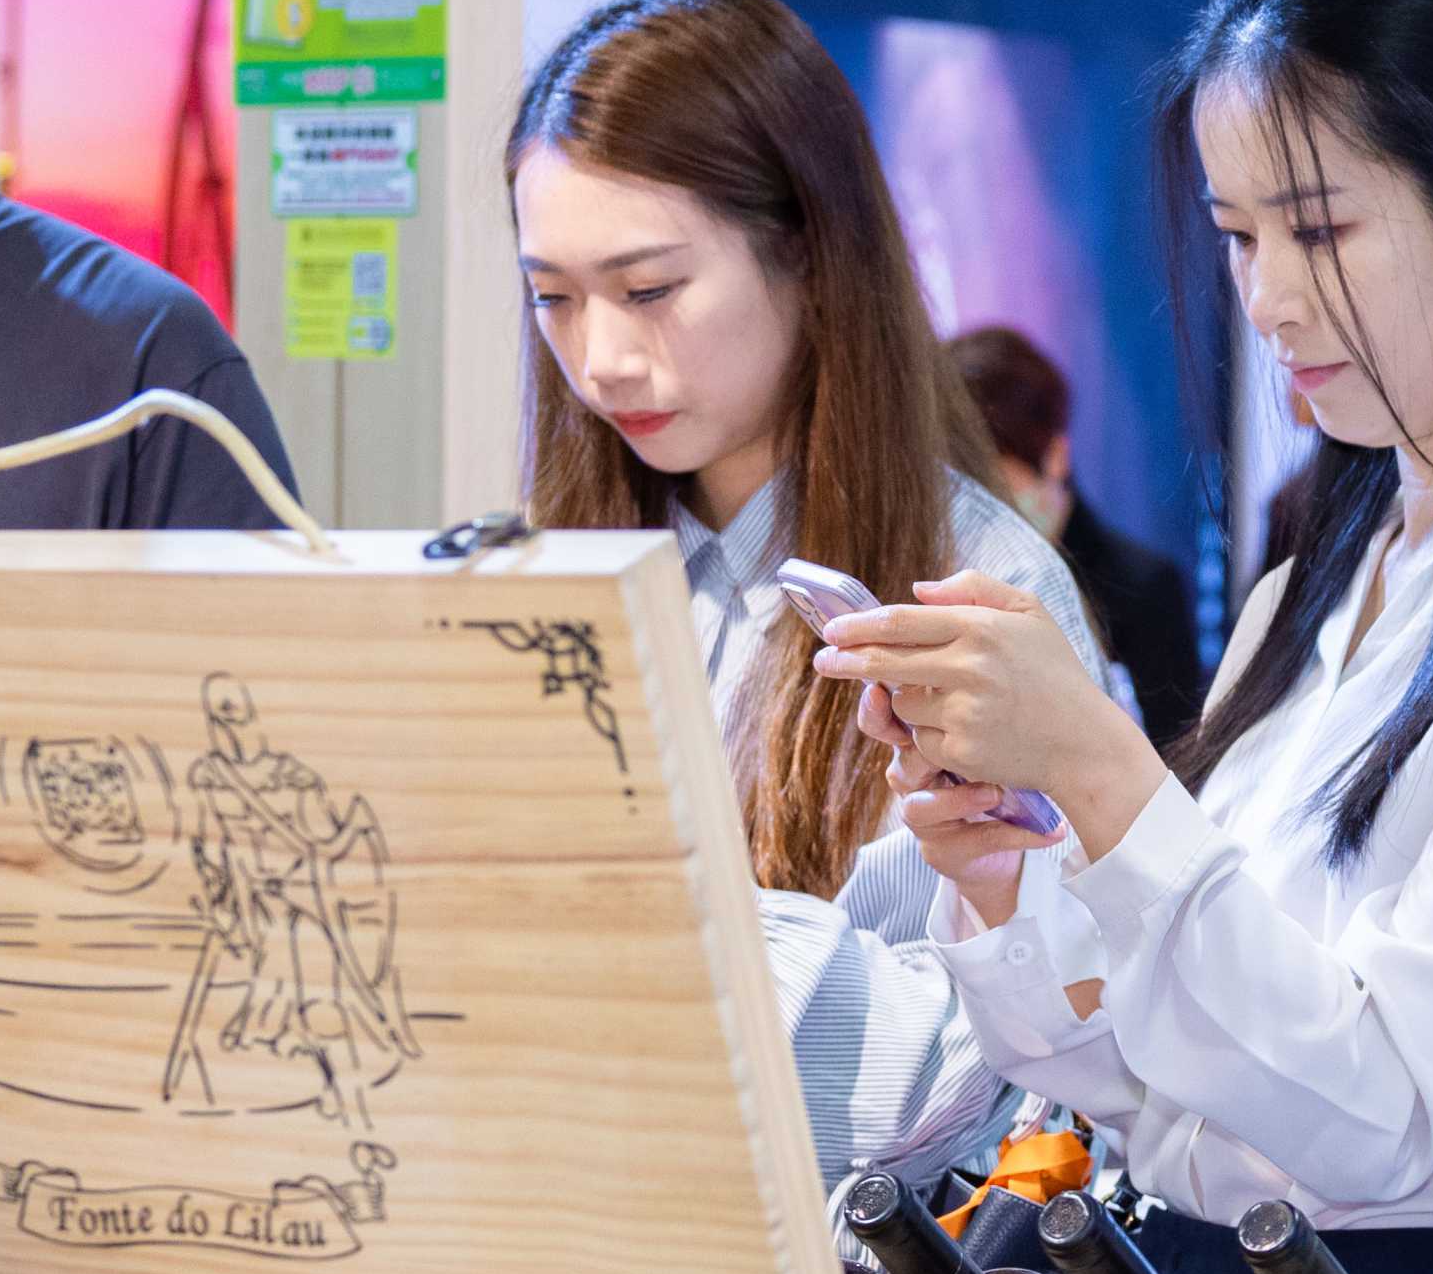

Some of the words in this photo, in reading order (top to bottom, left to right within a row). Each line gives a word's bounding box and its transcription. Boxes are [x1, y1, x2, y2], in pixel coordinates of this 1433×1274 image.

[47, 1194, 153, 1235] Fonte
[166, 1193, 209, 1238] do
[224, 1199, 329, 1247] Lilau
